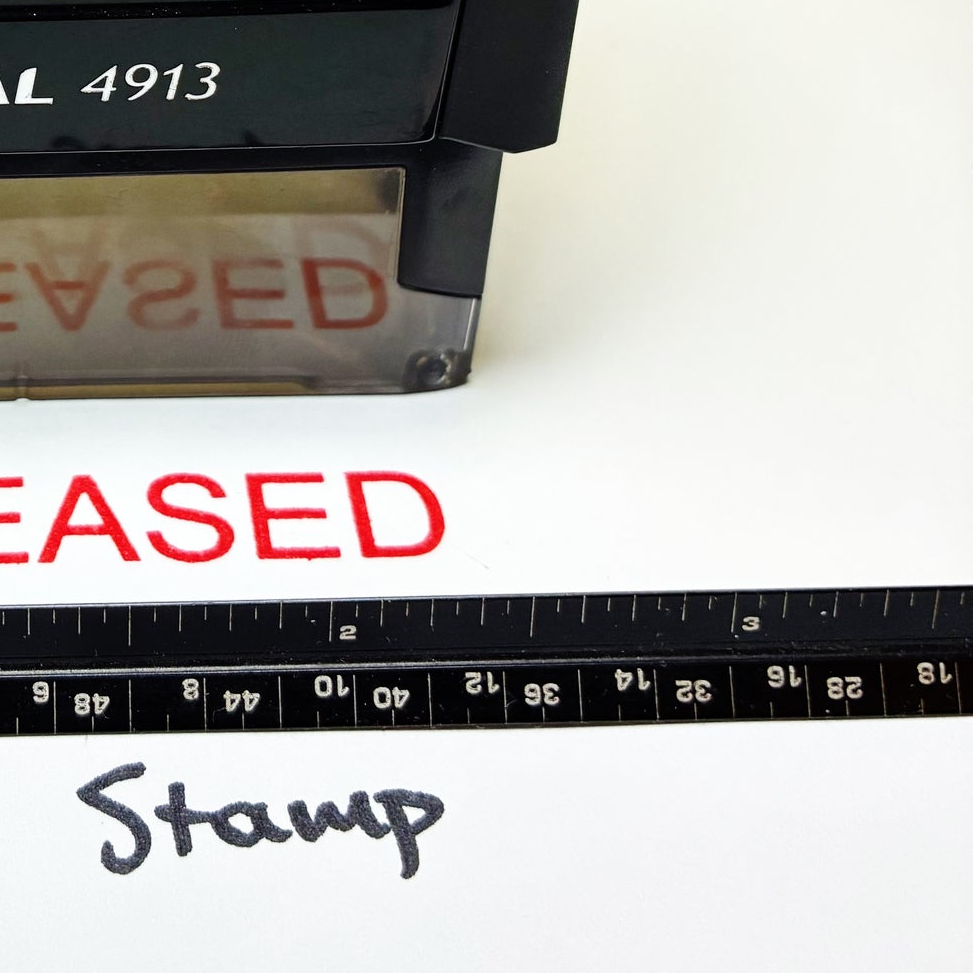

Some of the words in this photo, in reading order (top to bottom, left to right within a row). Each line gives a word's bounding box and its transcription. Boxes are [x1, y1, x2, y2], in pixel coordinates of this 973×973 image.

[80, 61, 221, 103] 4913
[339, 625, 357, 640] 2
[741, 616, 760, 631] 3
[73, 692, 111, 716] 48
[223, 689, 261, 713] 44
[372, 686, 410, 710] 40
[524, 682, 561, 706] 36
[675, 679, 713, 703] 32
[826, 676, 863, 700] 28
[182, 678, 200, 701] 8
[314, 675, 350, 698] 10
[464, 671, 500, 694] 12
[615, 667, 651, 692] 14
[767, 665, 802, 688] 16
[917, 661, 953, 685] 18
[76, 763, 446, 880] Stamp
